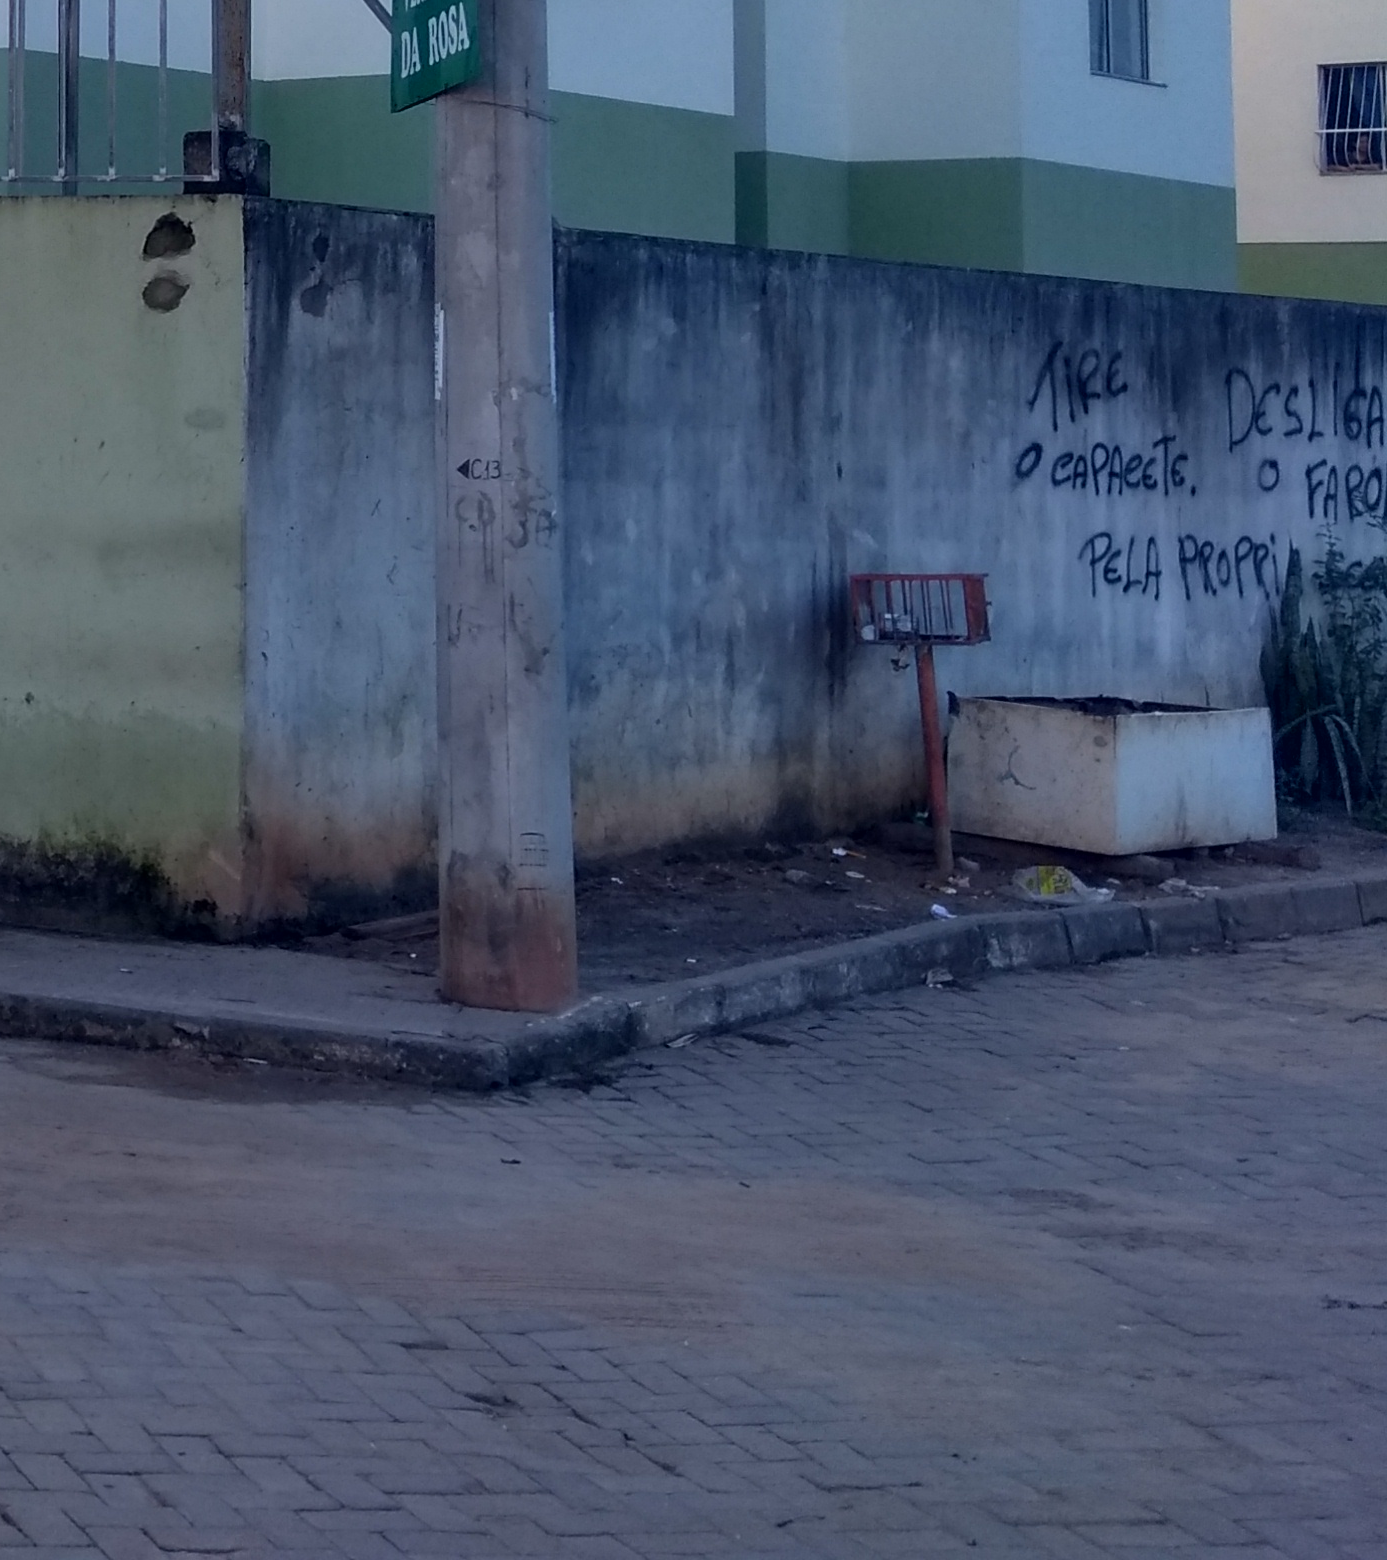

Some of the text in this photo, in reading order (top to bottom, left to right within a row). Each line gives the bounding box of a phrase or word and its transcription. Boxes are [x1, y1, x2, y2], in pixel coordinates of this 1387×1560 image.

[400, 1, 470, 79] DA ROSA
[1027, 340, 1128, 432] TIRE
[1015, 442, 1043, 480] O
[1258, 458, 1387, 523] O FARO
[1078, 531, 1162, 601] PELA
